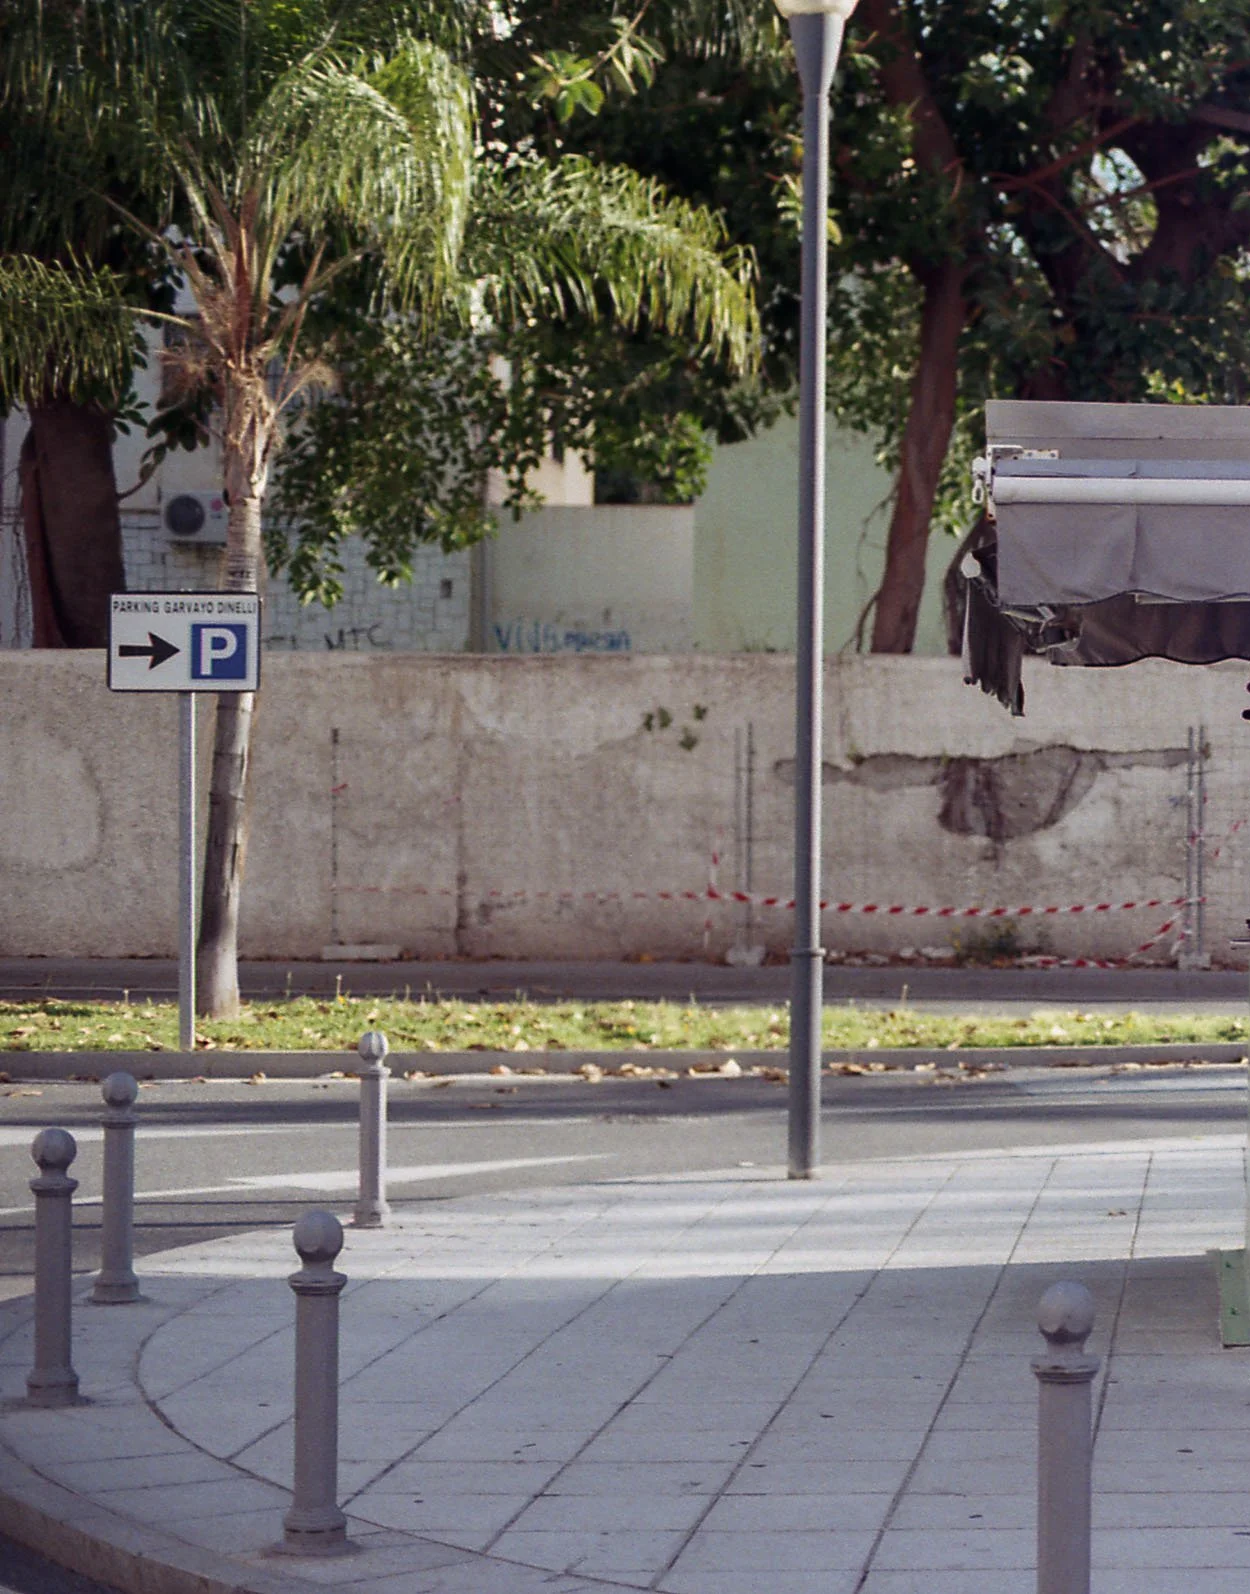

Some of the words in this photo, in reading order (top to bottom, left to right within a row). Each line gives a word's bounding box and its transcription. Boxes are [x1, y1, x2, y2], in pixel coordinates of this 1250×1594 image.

[113, 601, 159, 613] PARKING
[164, 601, 213, 613] GARVAYO
[217, 602, 256, 614] DINELLI
[200, 627, 237, 675] P
